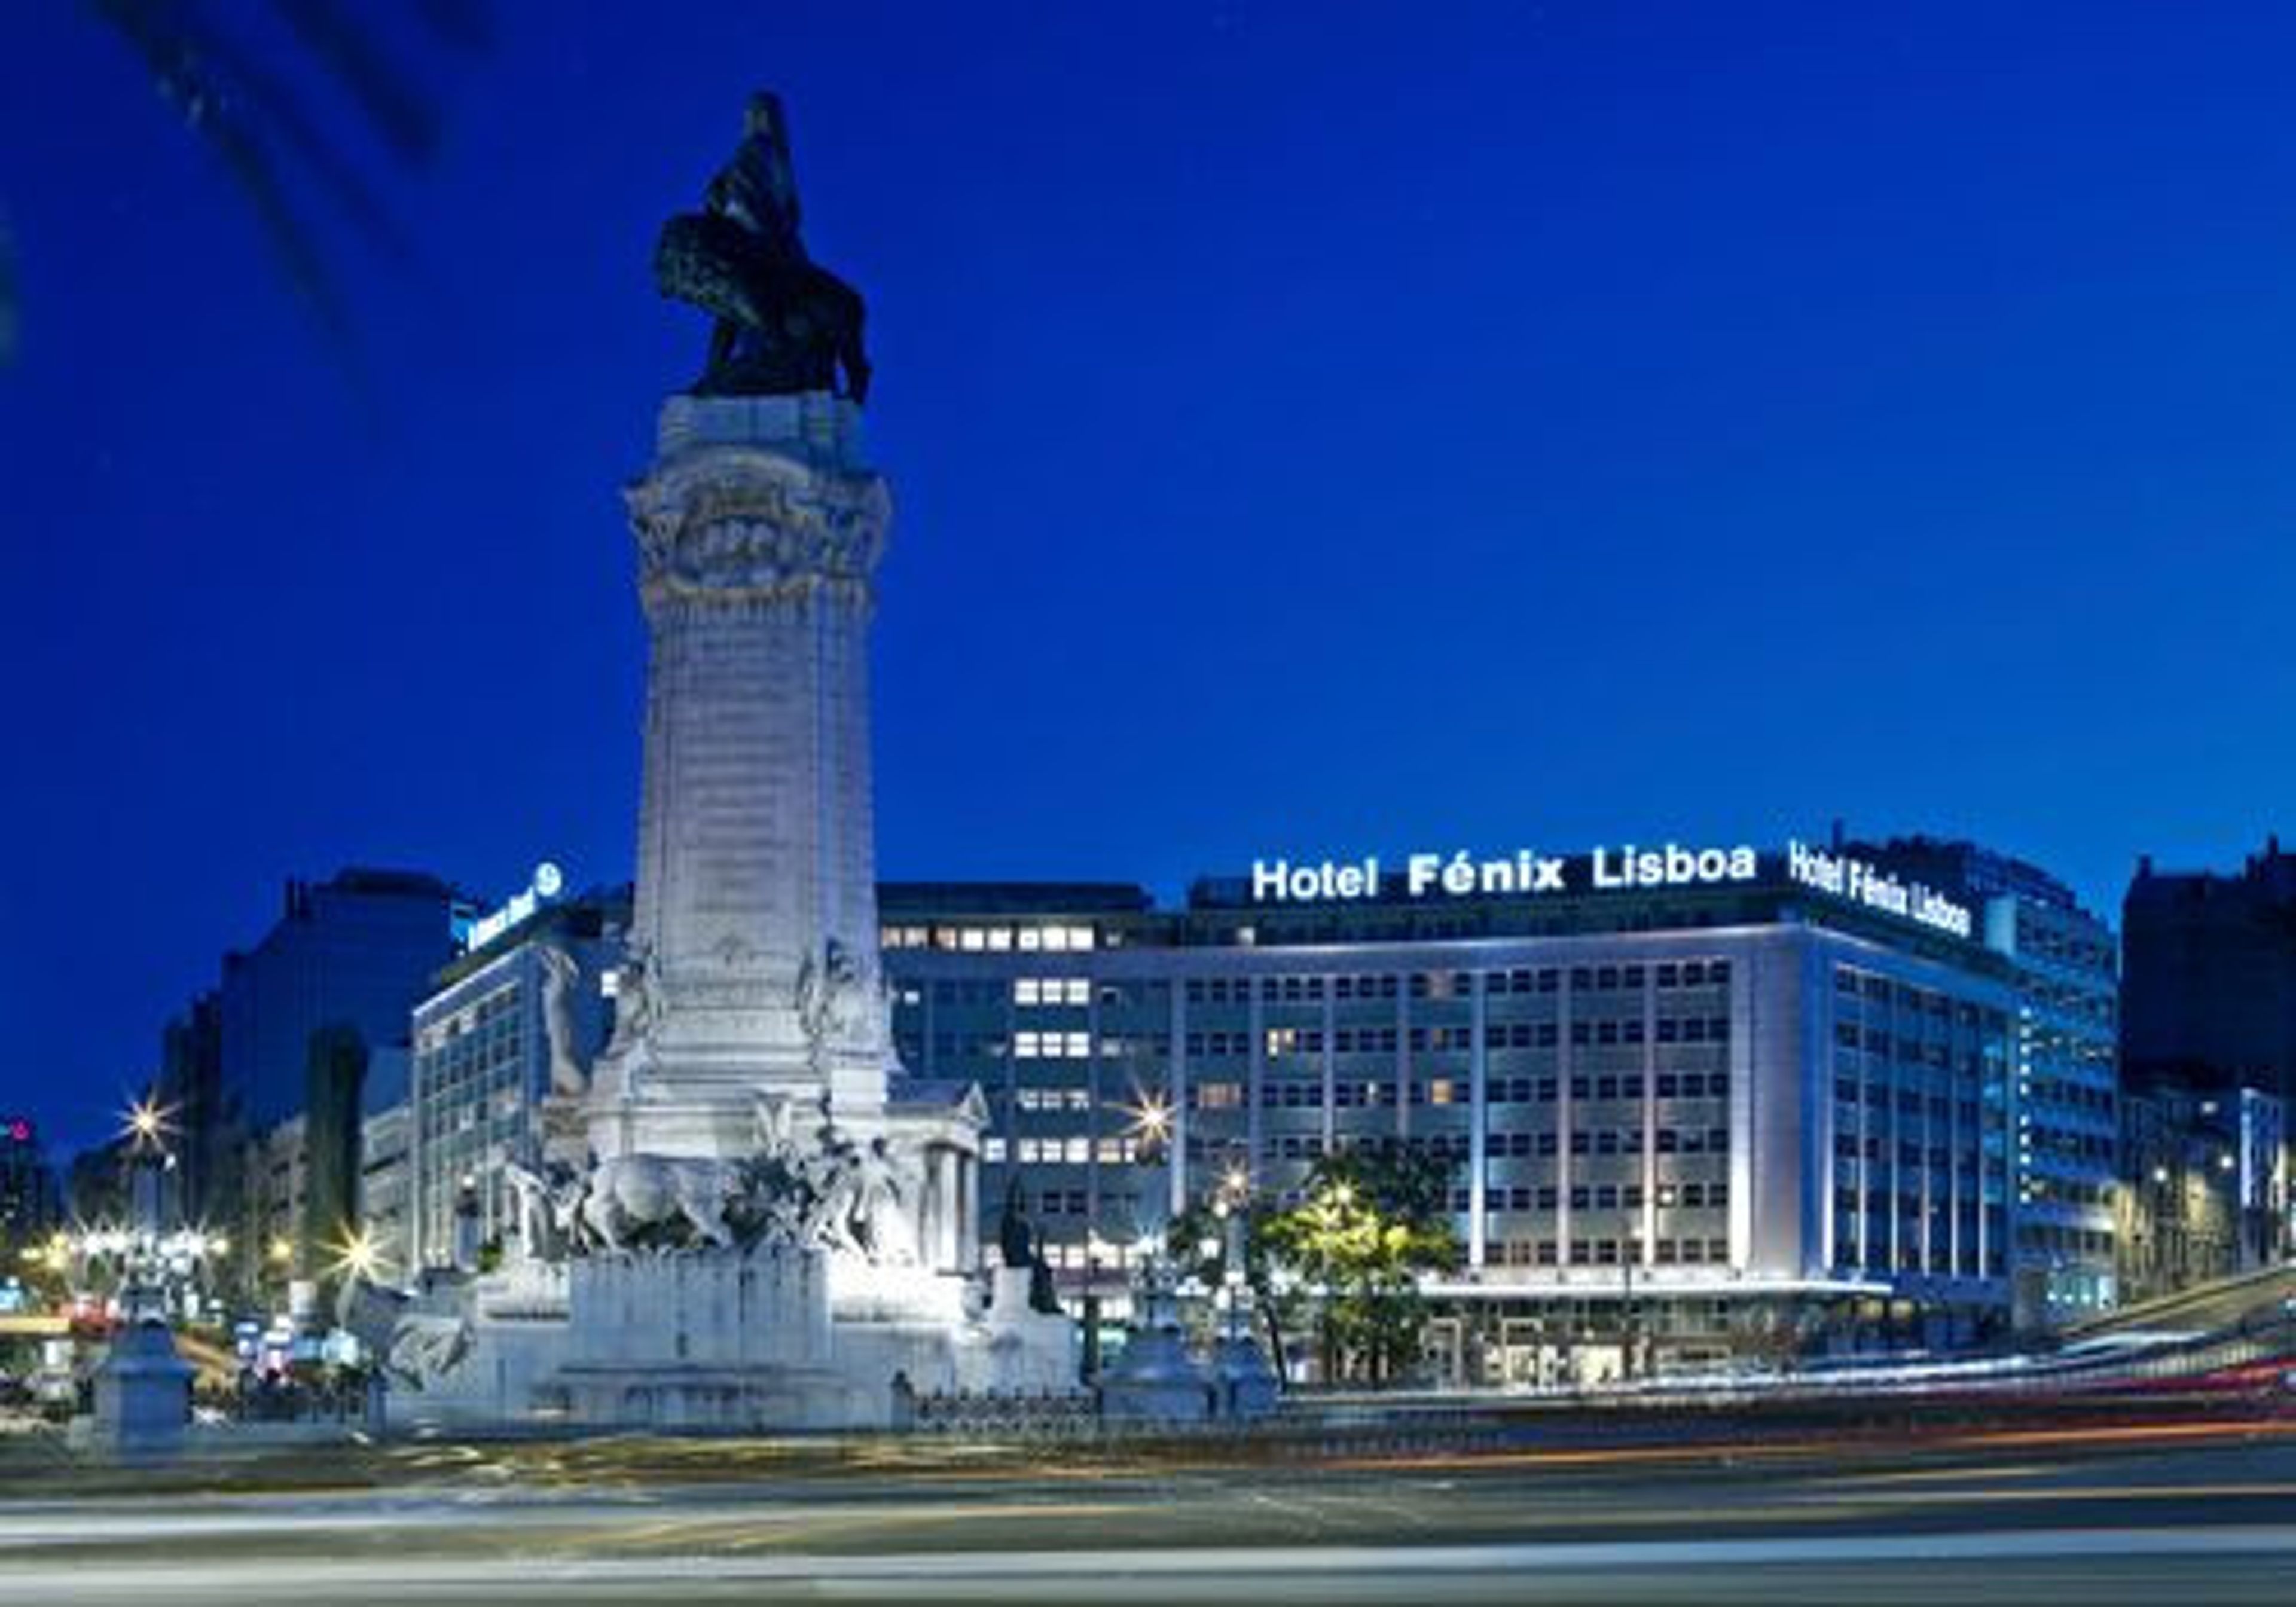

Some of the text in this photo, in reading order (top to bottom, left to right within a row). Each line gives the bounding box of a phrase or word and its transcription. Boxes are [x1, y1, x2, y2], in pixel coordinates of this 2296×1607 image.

[1253, 843, 1757, 901] Hotel Fénix Lisboa
[1790, 838, 1843, 893] Hotel
